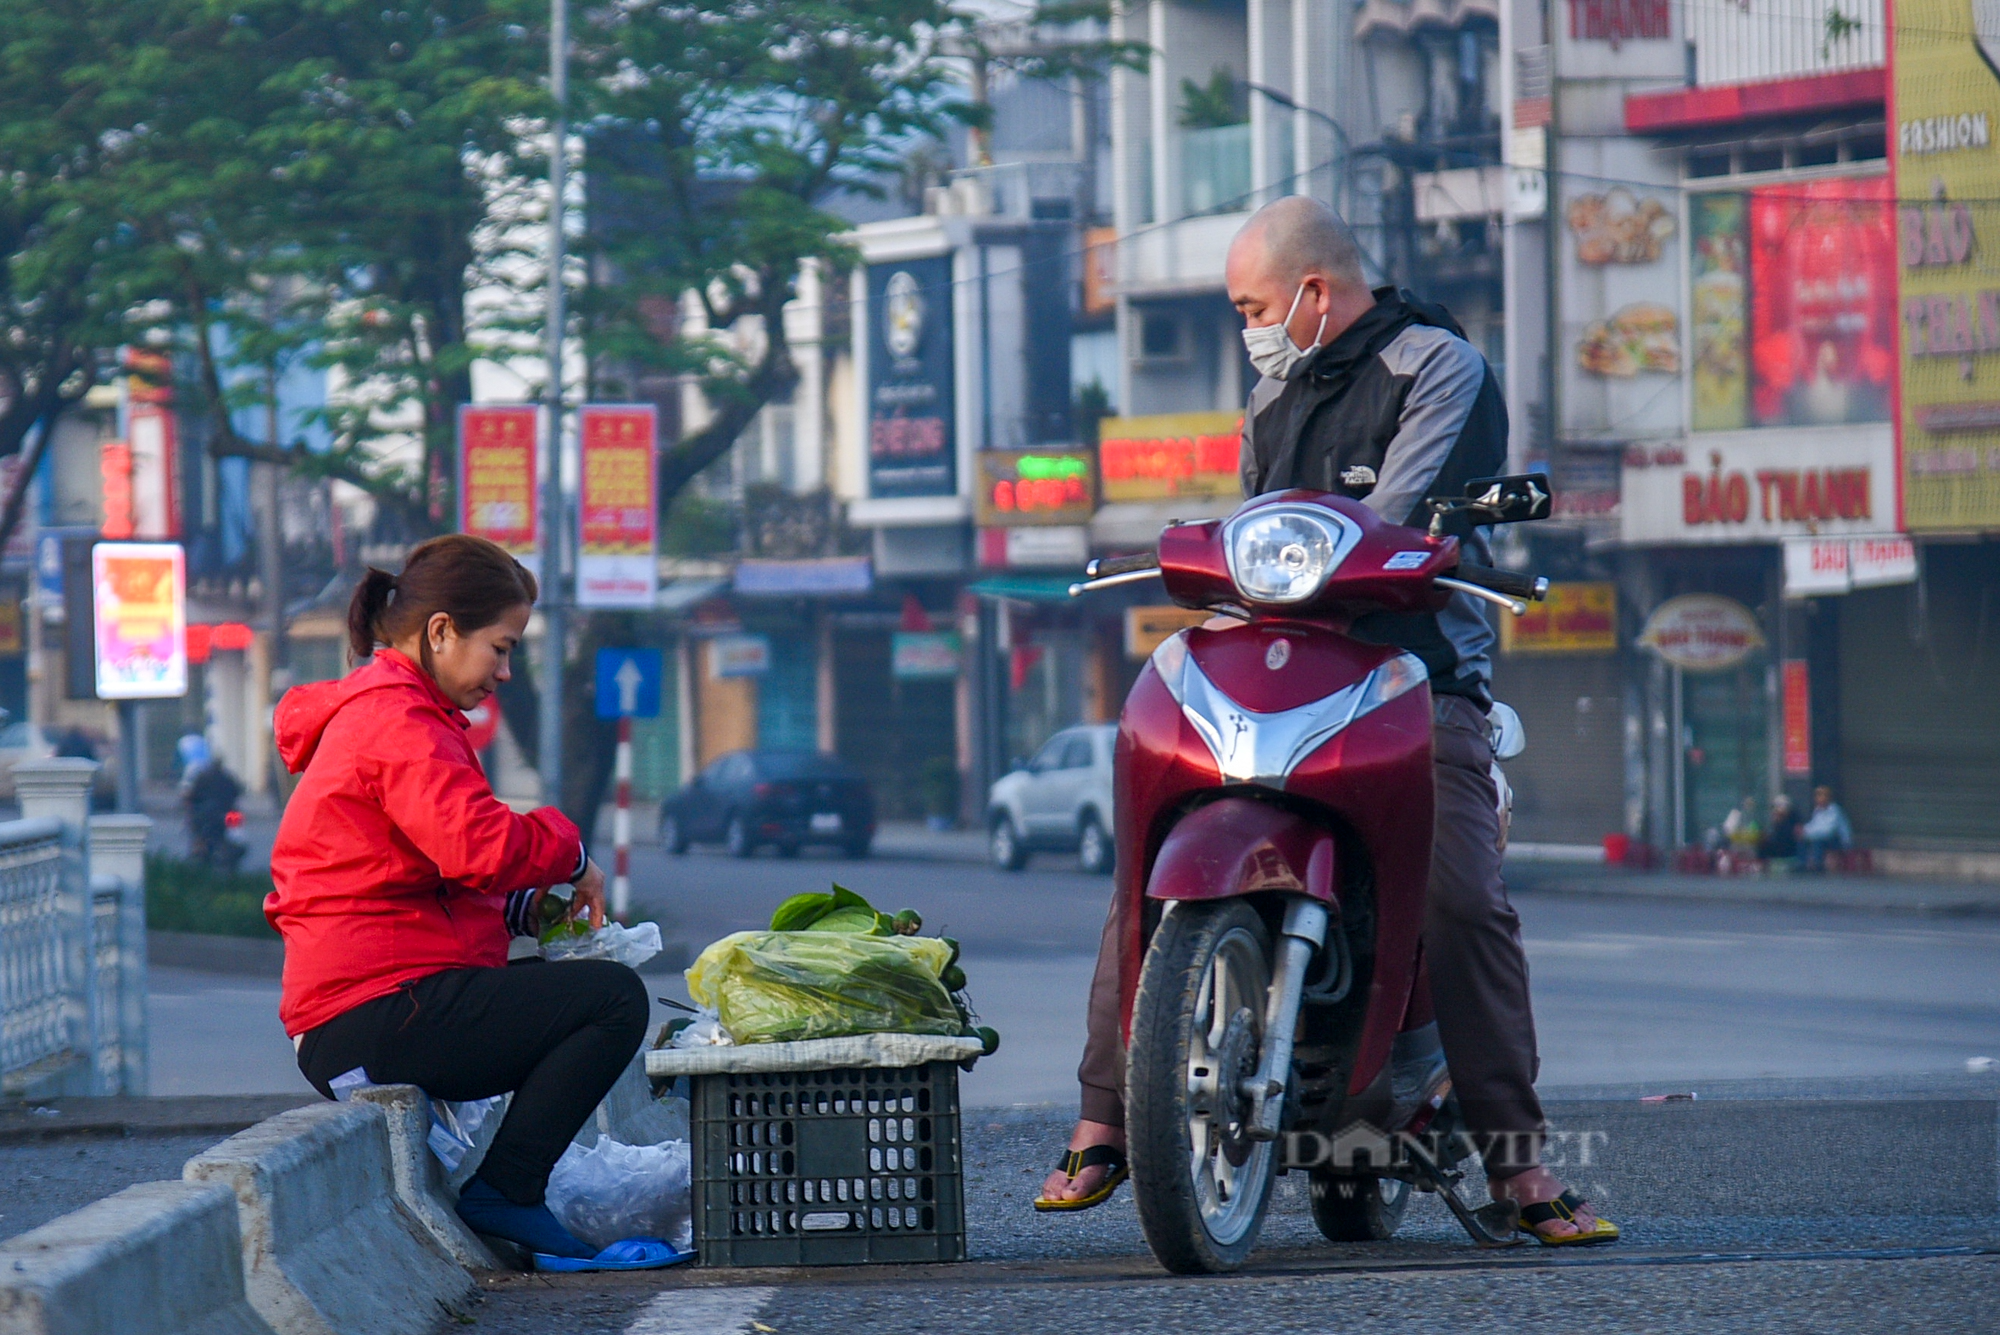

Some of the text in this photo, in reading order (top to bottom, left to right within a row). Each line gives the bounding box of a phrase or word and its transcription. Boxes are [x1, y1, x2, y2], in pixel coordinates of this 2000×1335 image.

[1900, 112, 1989, 154] FASHION
[1683, 451, 1871, 534] BẢO THẠNH
